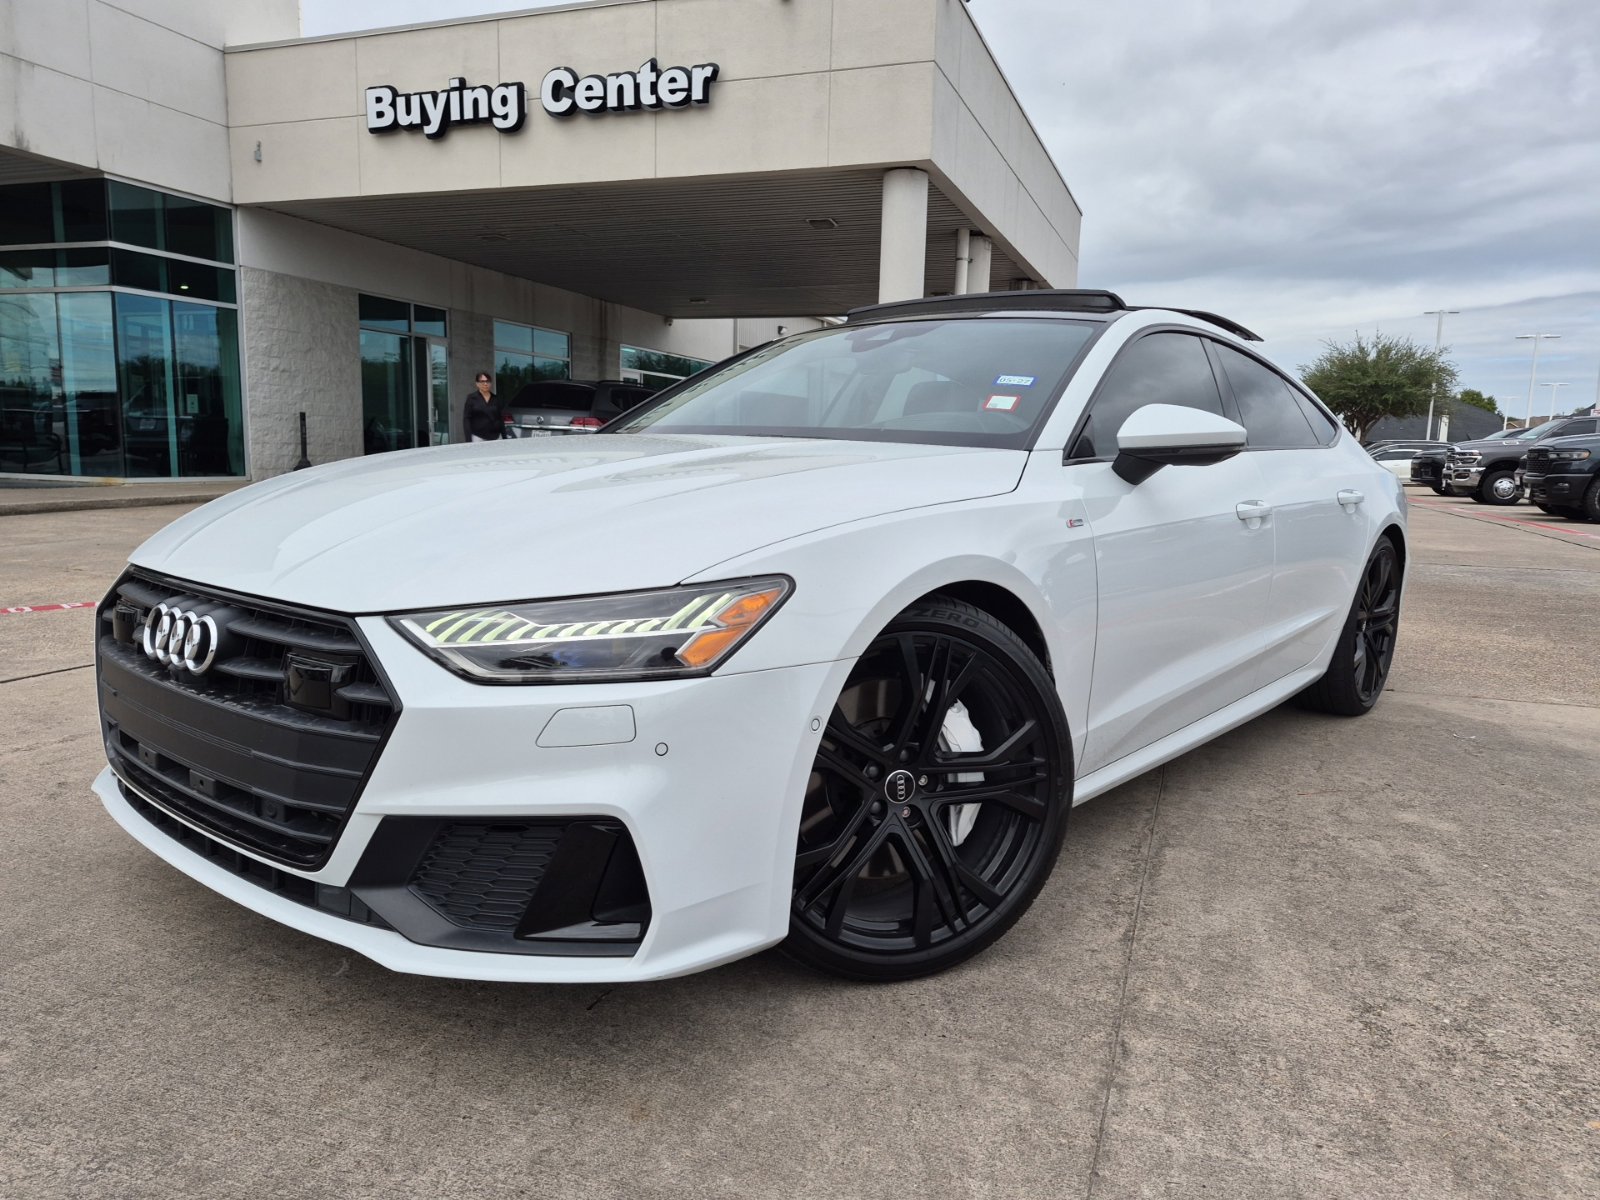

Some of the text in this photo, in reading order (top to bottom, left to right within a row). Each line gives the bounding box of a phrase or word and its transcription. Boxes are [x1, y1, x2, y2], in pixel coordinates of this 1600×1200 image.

[365, 58, 719, 138] Buying Center
[911, 608, 980, 629] ZERO
